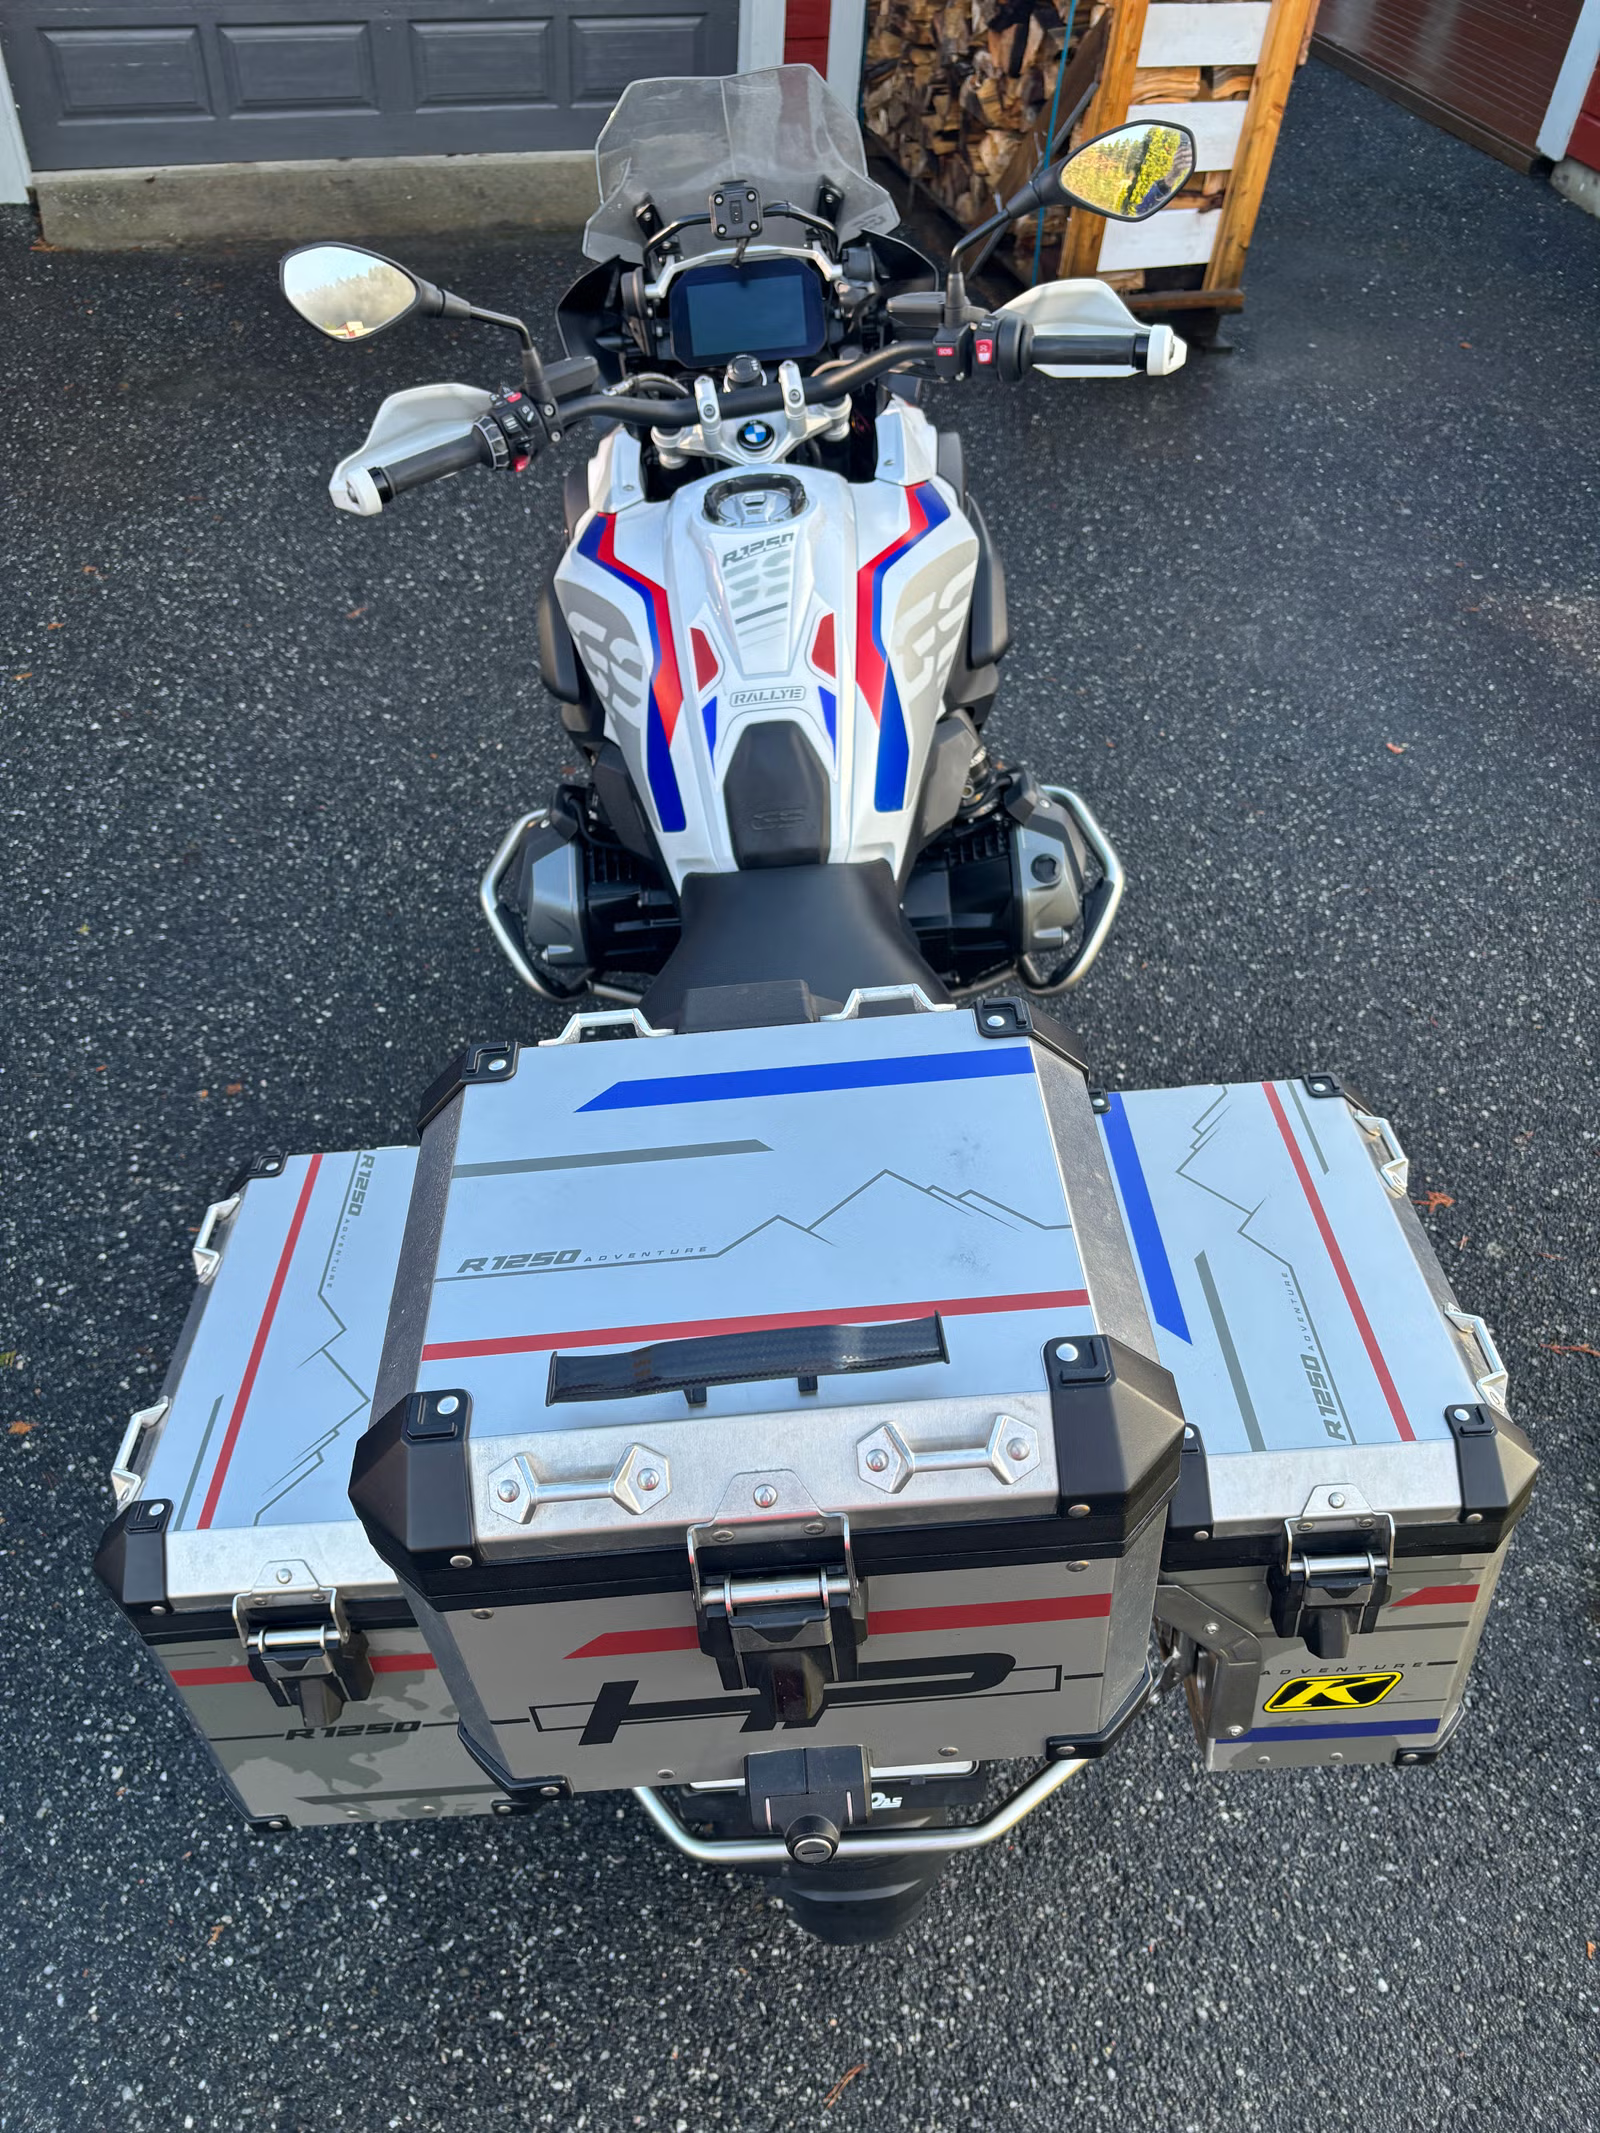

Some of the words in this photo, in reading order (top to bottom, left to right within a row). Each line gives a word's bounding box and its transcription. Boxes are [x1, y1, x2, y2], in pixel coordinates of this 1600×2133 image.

[733, 688, 802, 705] RALLYE
[326, 1218, 351, 1288] ADVENTURE
[583, 1246, 708, 1263] ADVENTURE
[1281, 1272, 1316, 1352] ADVENTURE
[1259, 1662, 1424, 1676] ADVENTURE
